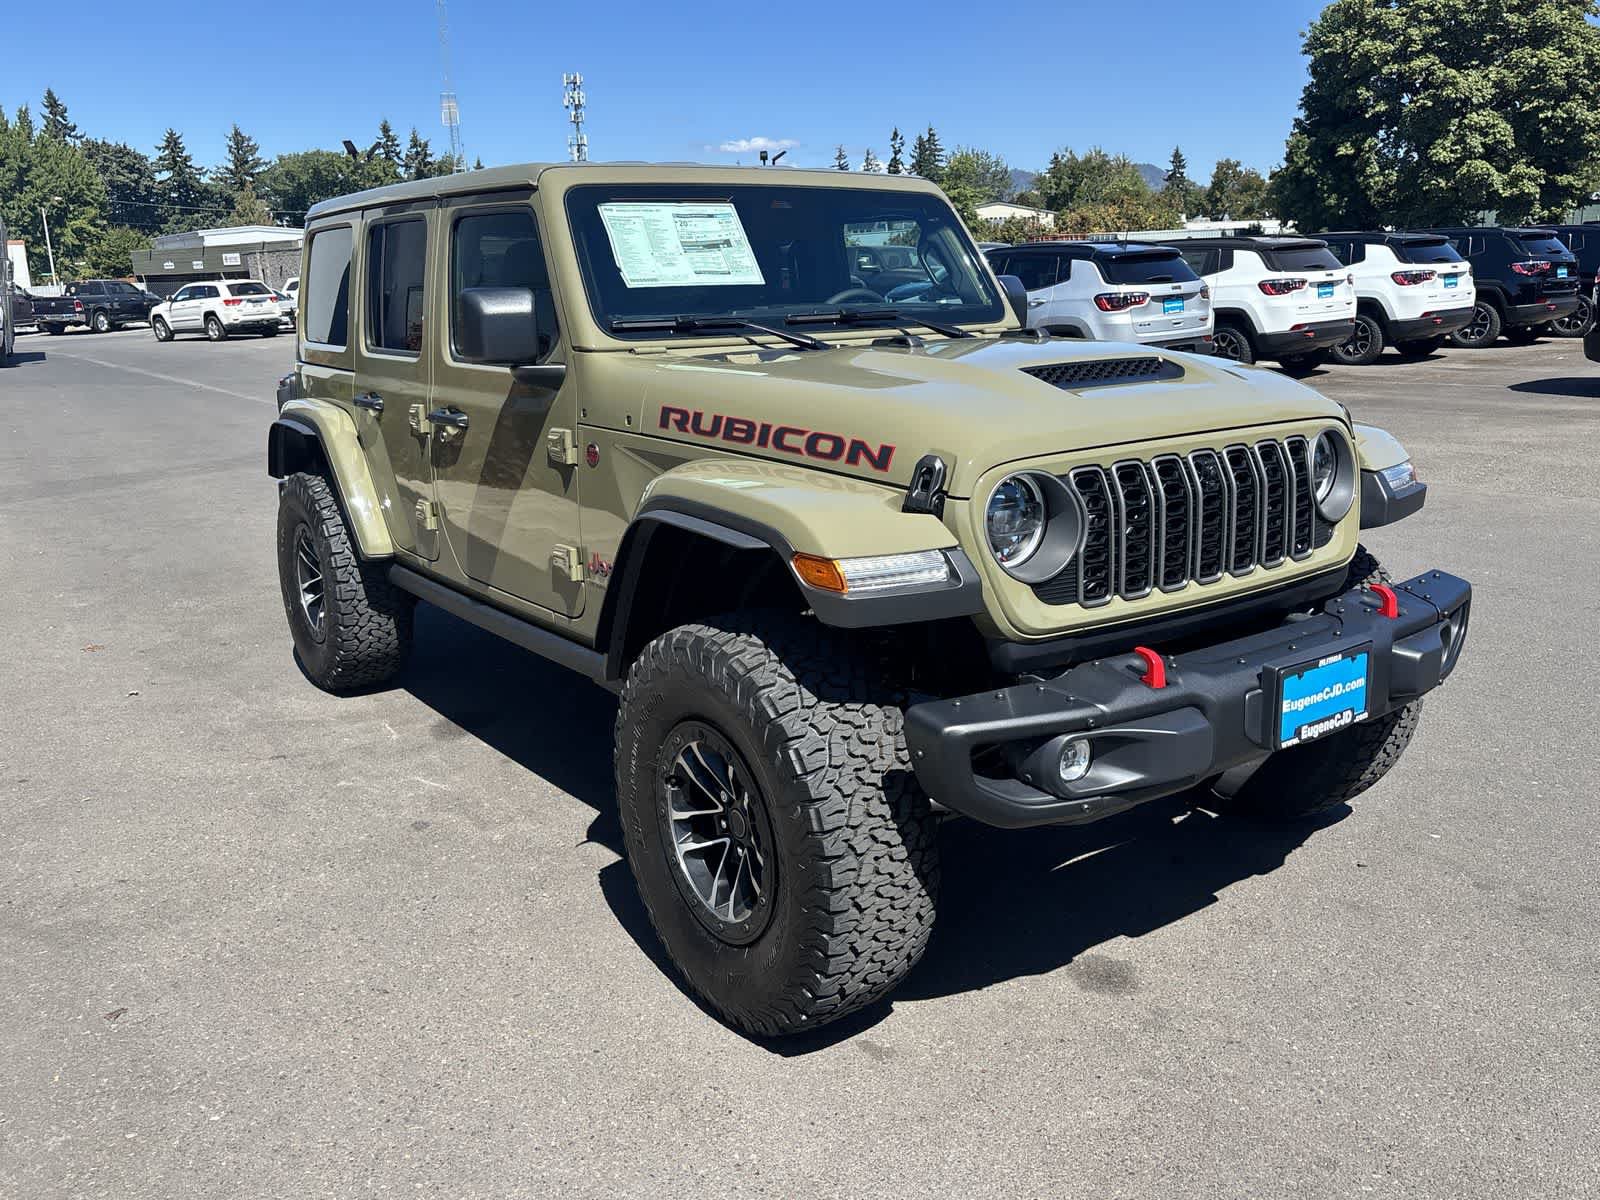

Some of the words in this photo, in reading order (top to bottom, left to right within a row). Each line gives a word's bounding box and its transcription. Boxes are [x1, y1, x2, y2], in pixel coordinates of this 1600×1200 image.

[658, 405, 896, 473] RUBICON
[1282, 678, 1364, 712] EugeneCJD.com
[1301, 710, 1352, 739] EugeneCJD
